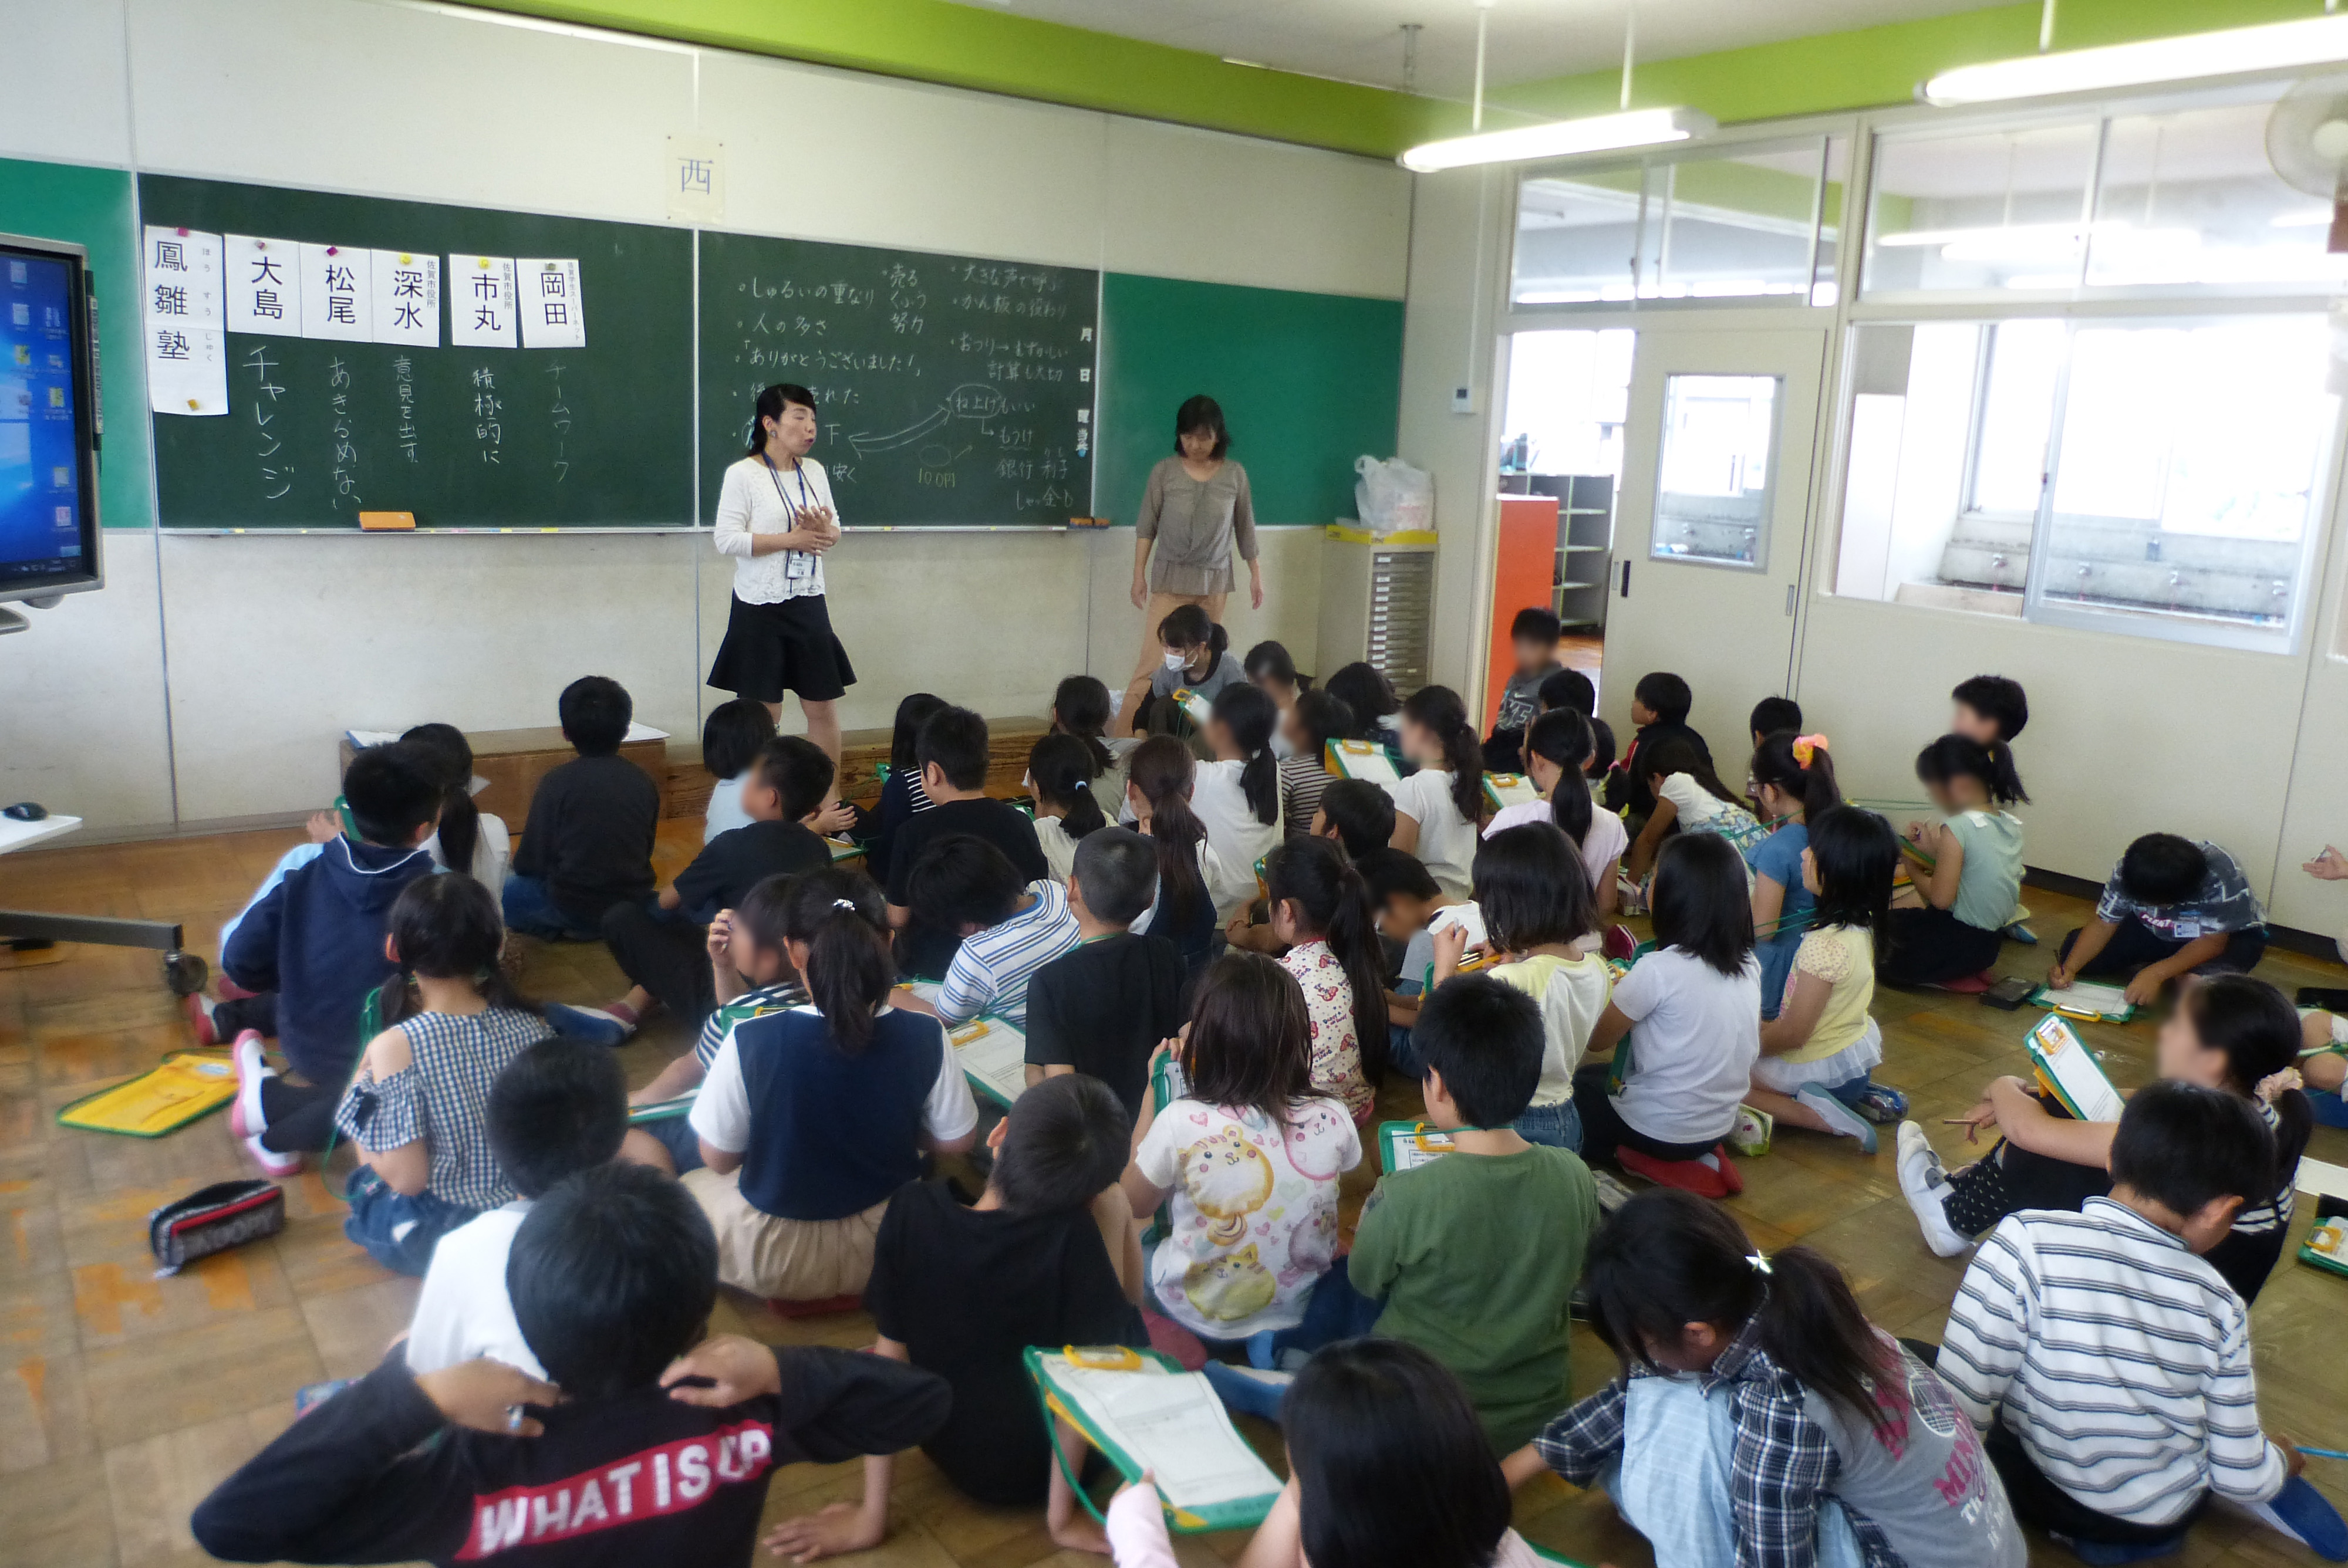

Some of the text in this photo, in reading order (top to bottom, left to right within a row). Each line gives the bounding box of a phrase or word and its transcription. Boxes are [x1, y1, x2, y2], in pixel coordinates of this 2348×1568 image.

[678, 158, 714, 195] 西
[154, 241, 190, 360] 鳳雛塾
[251, 256, 284, 320] 大島
[325, 264, 356, 324] 松尾
[394, 270, 423, 329] 深水
[427, 260, 436, 309] 佐賀市役所
[471, 273, 501, 331] 市丸
[503, 262, 513, 310] 佐賀市役所
[541, 273, 568, 325] 岡田
[1080, 327, 1092, 342] 月
[1079, 369, 1090, 382] 日
[242, 346, 295, 499] チャレンジ
[480, 1461, 641, 1556] WHAT
[653, 1444, 711, 1508] IS
